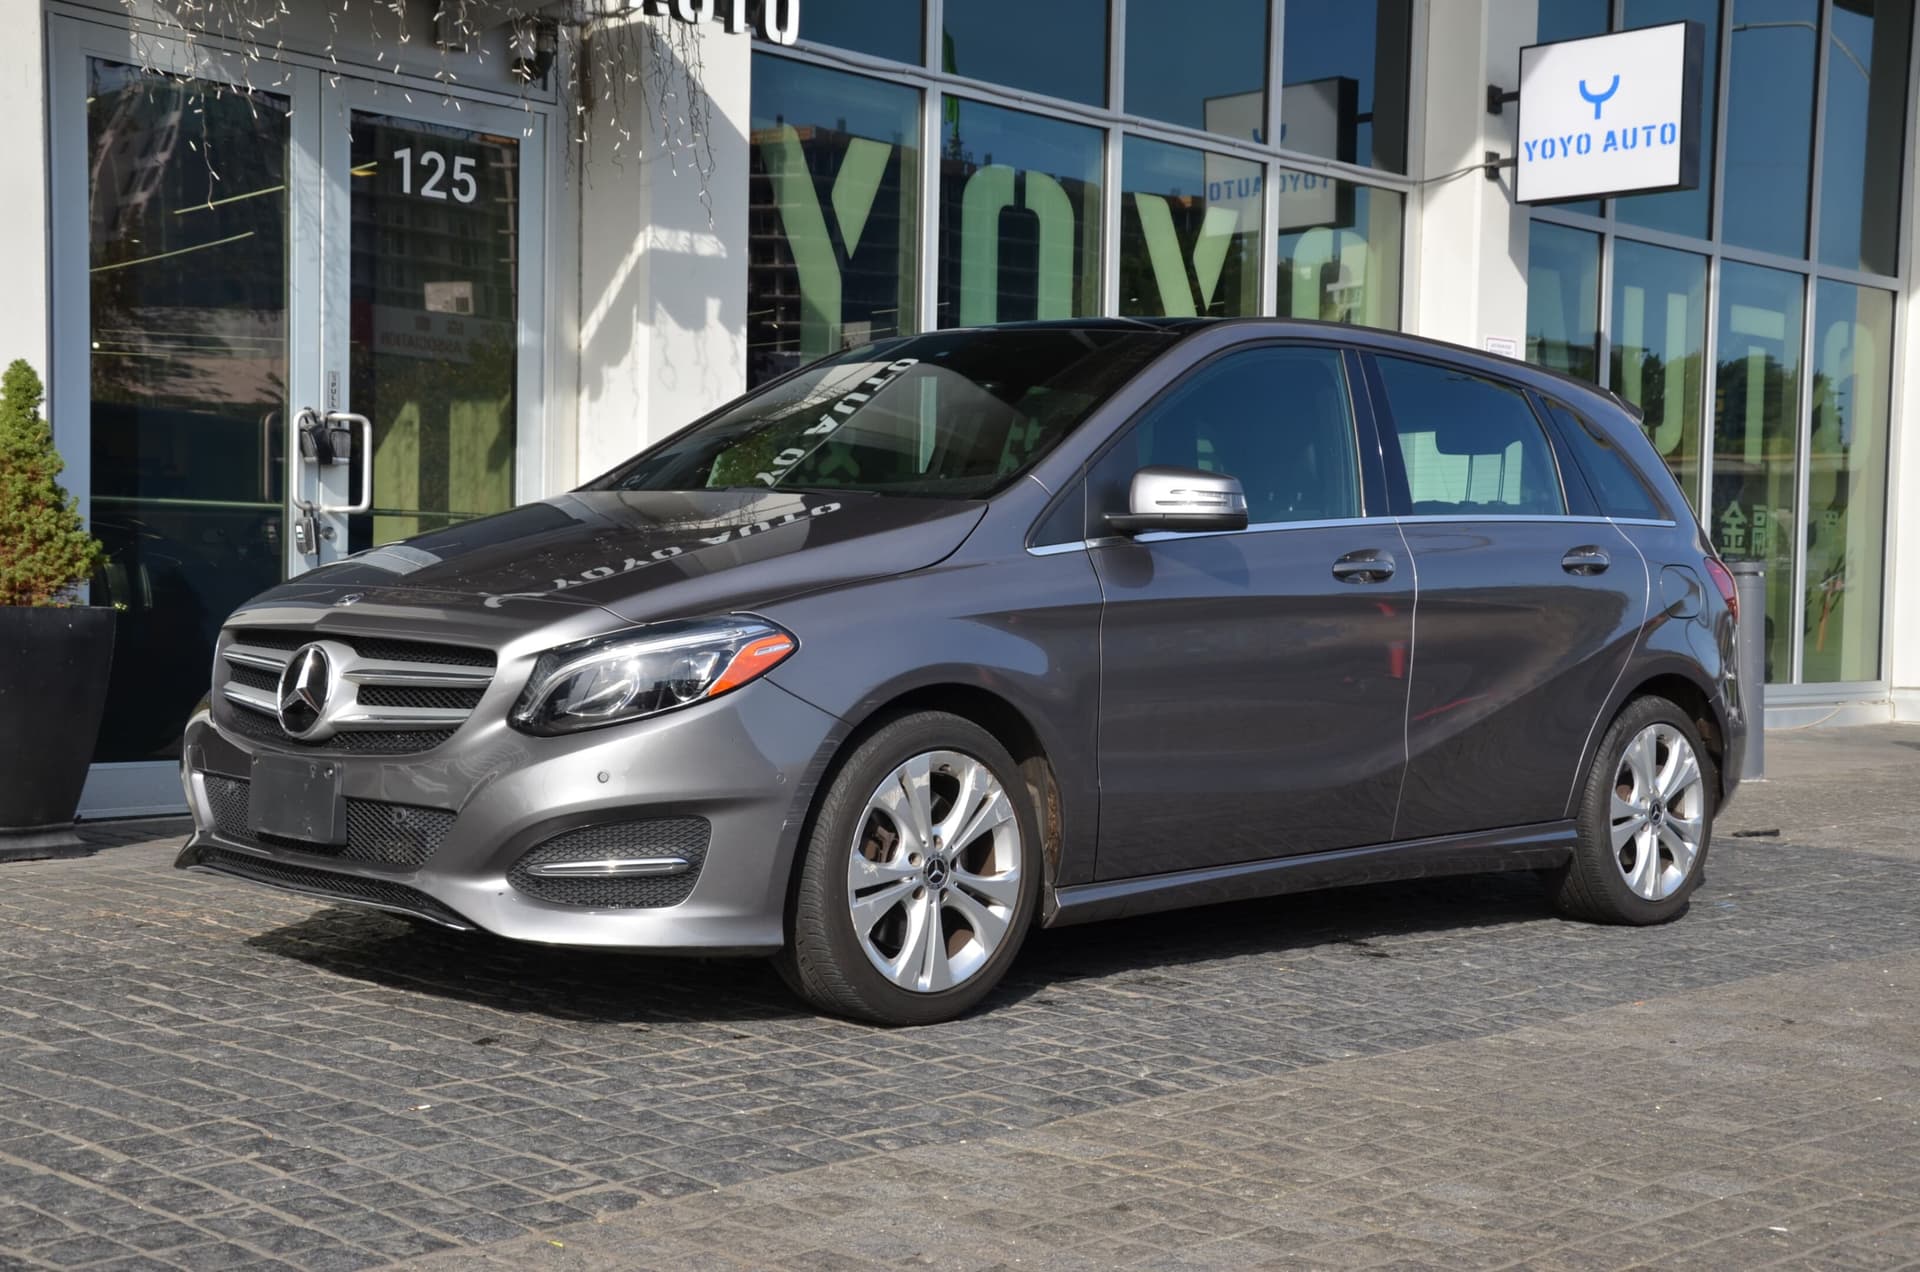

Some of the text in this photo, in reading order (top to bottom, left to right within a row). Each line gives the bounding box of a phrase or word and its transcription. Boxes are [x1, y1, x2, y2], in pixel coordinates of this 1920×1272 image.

[1524, 122, 1677, 162] YOYO AUTO
[394, 147, 477, 203] 125
